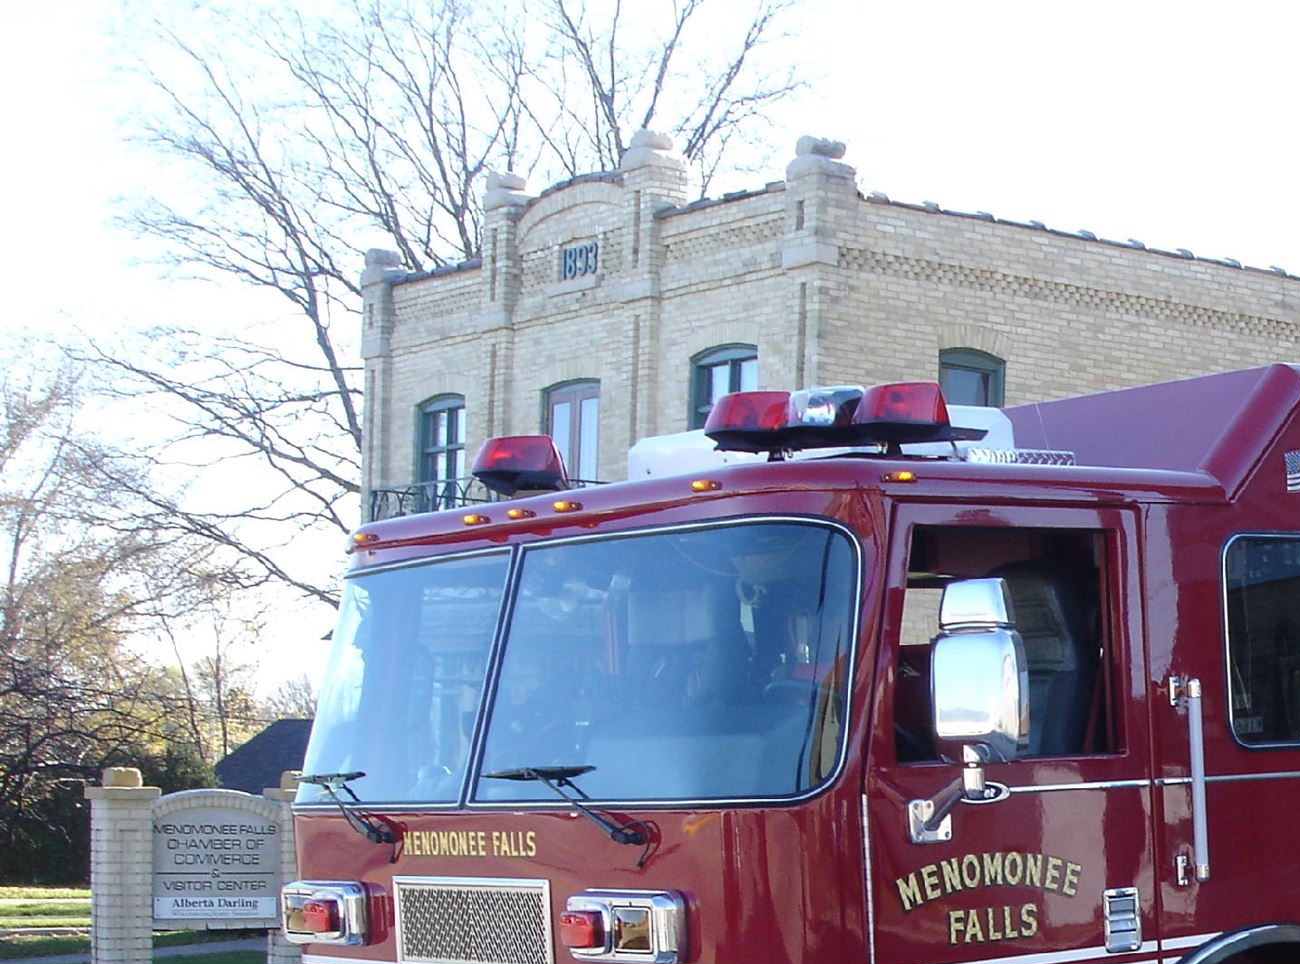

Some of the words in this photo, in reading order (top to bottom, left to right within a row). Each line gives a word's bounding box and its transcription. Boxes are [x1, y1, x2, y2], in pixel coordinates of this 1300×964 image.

[153, 824, 237, 835] MENOMONEE
[240, 825, 276, 835] FALLS
[167, 839, 242, 850] CHAMBER
[246, 839, 265, 850] OF
[403, 831, 486, 856] MENOMONEE
[492, 831, 536, 857] FALLS
[174, 853, 260, 865] COMMERCE
[211, 868, 221, 878] &
[163, 880, 212, 891] VISITOR
[217, 880, 267, 891] CENTER
[896, 851, 1082, 911] MENOMONEE
[173, 898, 215, 908] Alberta
[217, 898, 259, 910] Darling
[949, 903, 1038, 945] FALLS
